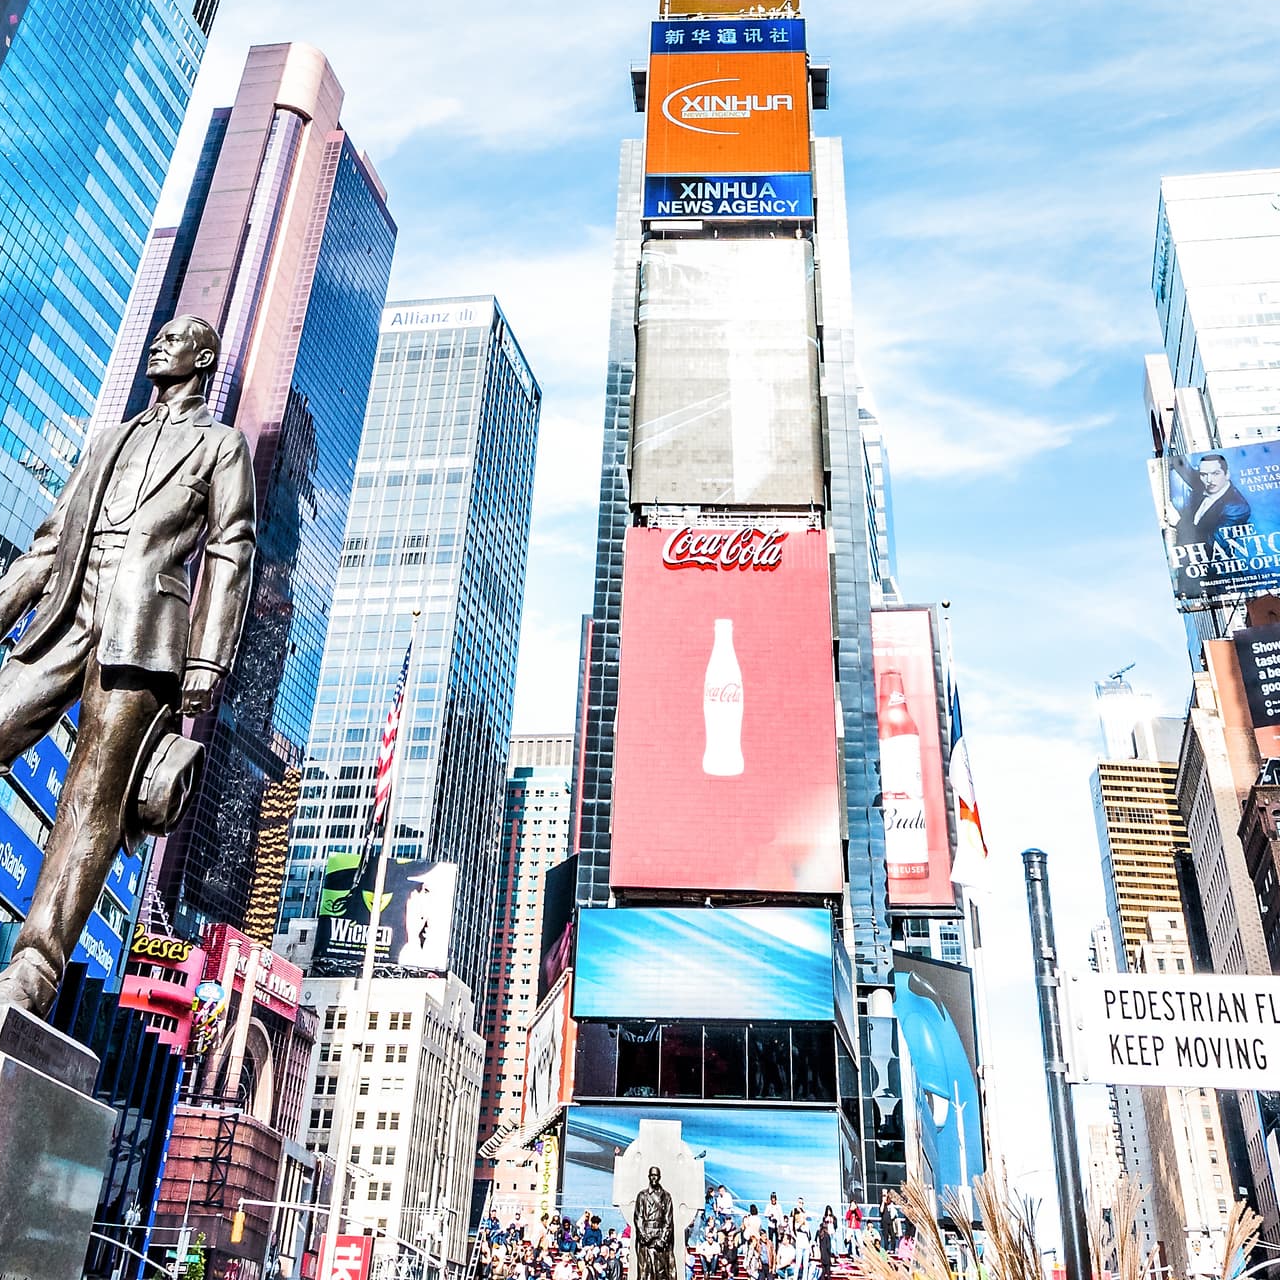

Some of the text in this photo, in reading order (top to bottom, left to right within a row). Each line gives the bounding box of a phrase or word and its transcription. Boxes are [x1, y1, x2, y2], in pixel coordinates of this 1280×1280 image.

[665, 28, 790, 45] 新华通讯社
[681, 94, 793, 112] XINHUA
[680, 182, 777, 200] XINHUA
[657, 200, 799, 214] NEWS AGENCY
[391, 312, 450, 327] Allianz
[1240, 468, 1261, 478] LET
[1218, 523, 1257, 539] THE
[662, 526, 788, 569] Coca-Cola
[1185, 563, 1210, 579] OF
[1211, 559, 1249, 575] THE
[3, 845, 28, 889] Stanley
[1104, 990, 1249, 1023] PEDESTRIAN
[1110, 1035, 1267, 1070] KEEP MOVING
